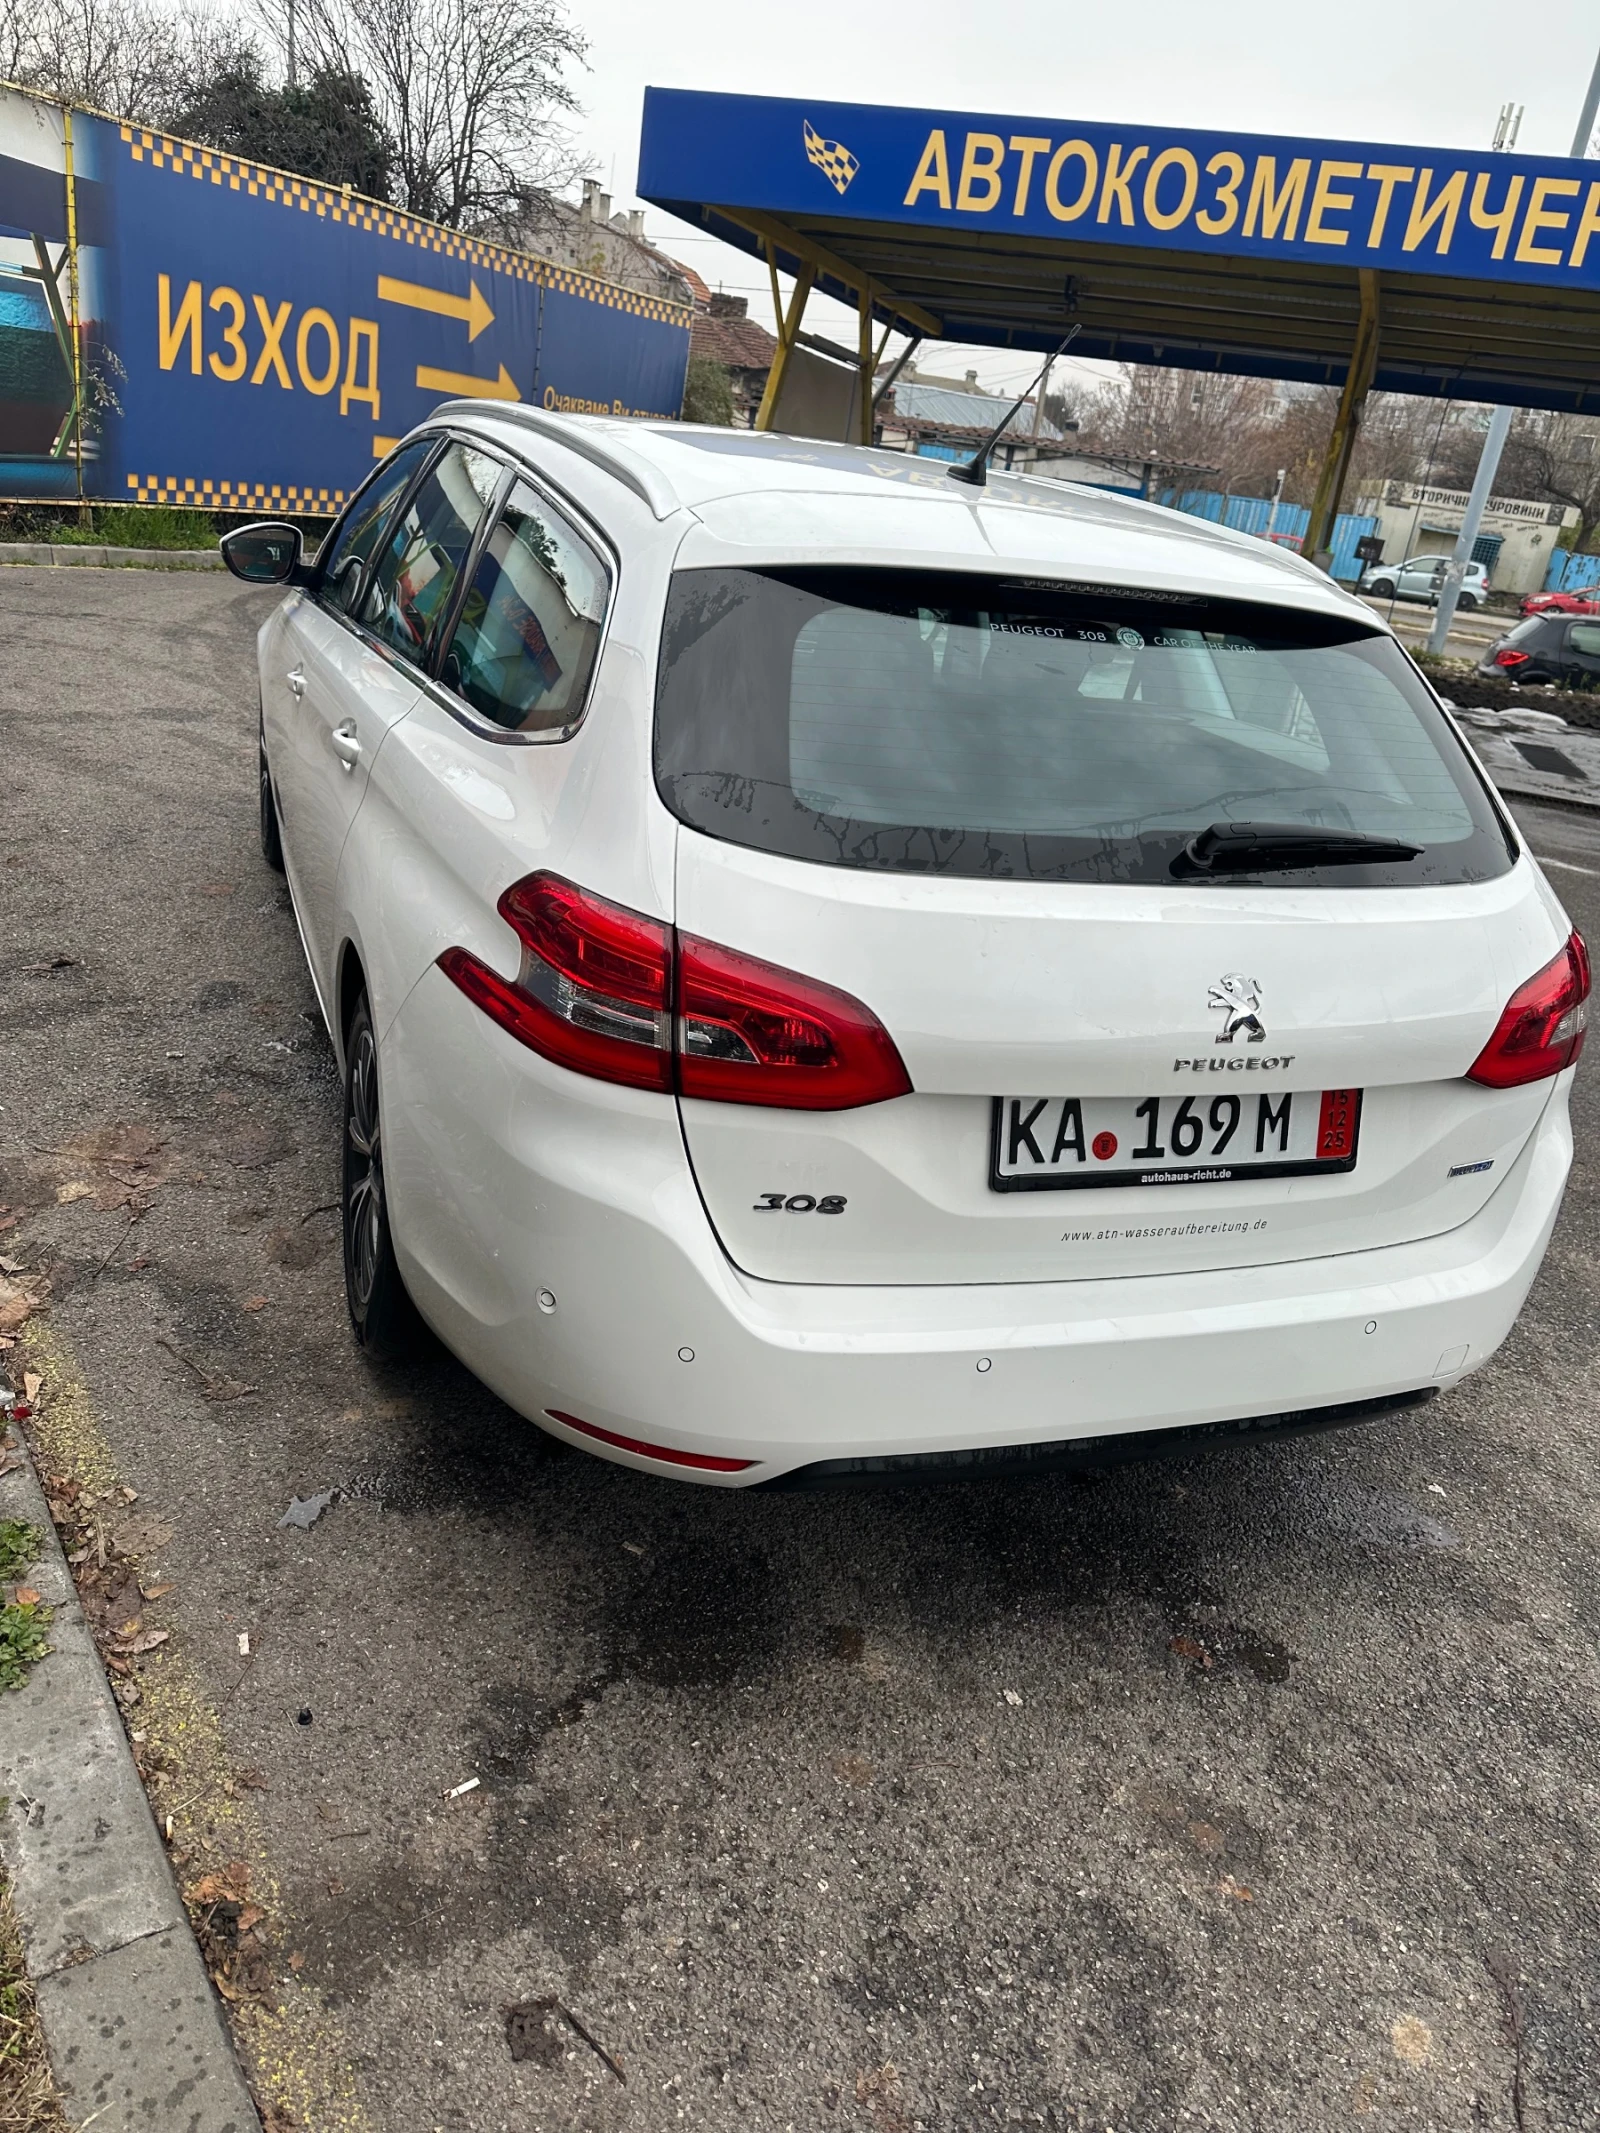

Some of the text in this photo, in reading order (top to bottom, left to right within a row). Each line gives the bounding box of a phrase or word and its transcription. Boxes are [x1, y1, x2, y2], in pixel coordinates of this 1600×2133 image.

[158, 273, 380, 420] ИЗХОД
[990, 623, 1065, 638] PEUGEOT
[1077, 630, 1107, 642] 308
[1153, 636, 1179, 647] CAR
[1181, 638, 1199, 649] OF
[1202, 641, 1226, 652] THE
[1226, 643, 1258, 655] YEAR
[1173, 1056, 1296, 1072] PEUGEOT
[1328, 1109, 1347, 1127] 12
[1008, 1098, 1087, 1164] KA
[1132, 1095, 1241, 1159] 169
[1255, 1092, 1292, 1153] M
[1323, 1130, 1345, 1149] 25
[1140, 1168, 1232, 1184] autohaus-richt.de
[752, 1193, 848, 1214] 308
[1060, 1218, 1268, 1242] www.atn-wasseraufbereitung.de
